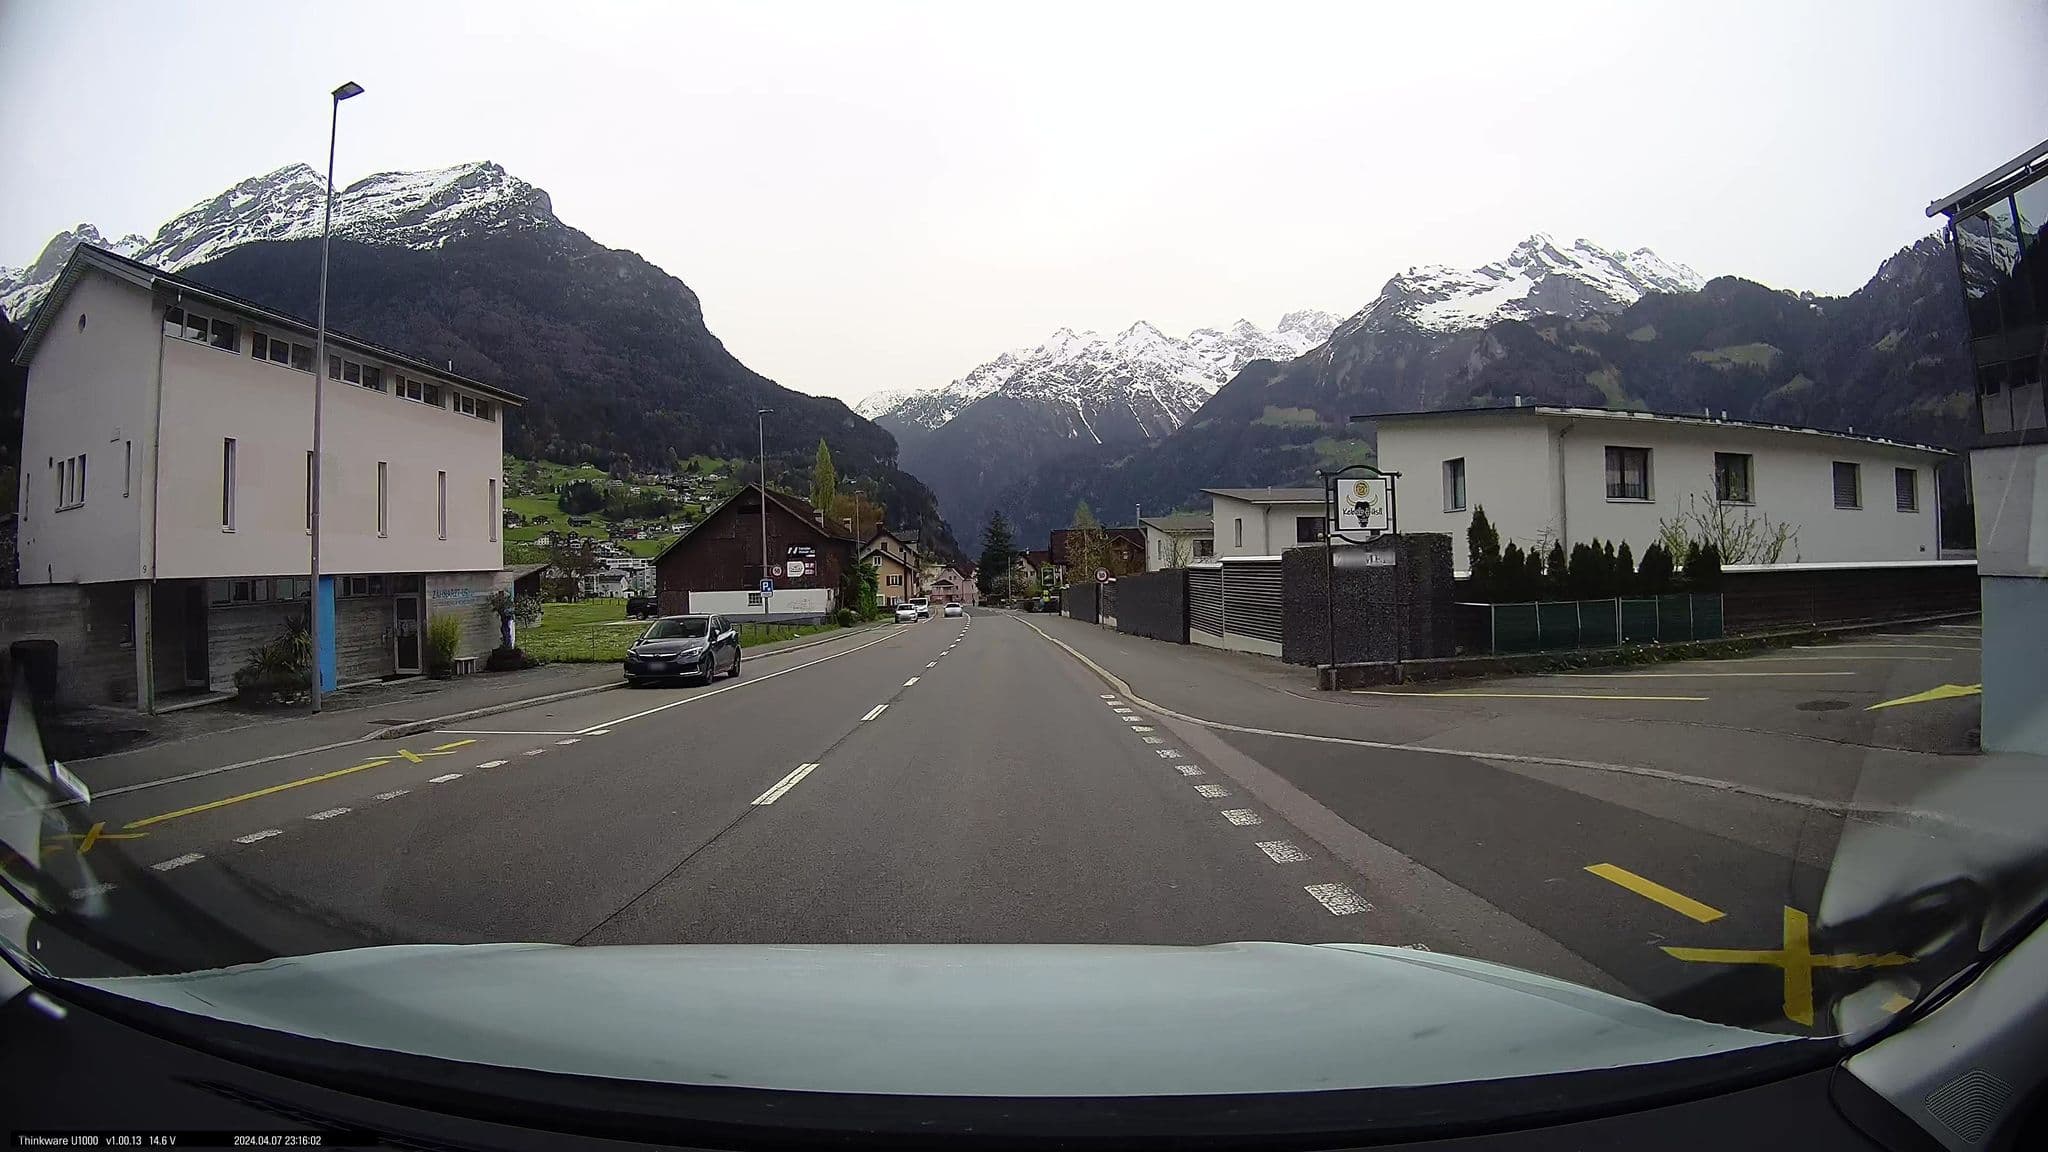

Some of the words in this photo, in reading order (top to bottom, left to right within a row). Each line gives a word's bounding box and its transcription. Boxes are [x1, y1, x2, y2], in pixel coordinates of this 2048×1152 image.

[142, 564, 147, 574] 9
[774, 567, 781, 575] 50
[762, 581, 769, 591] P
